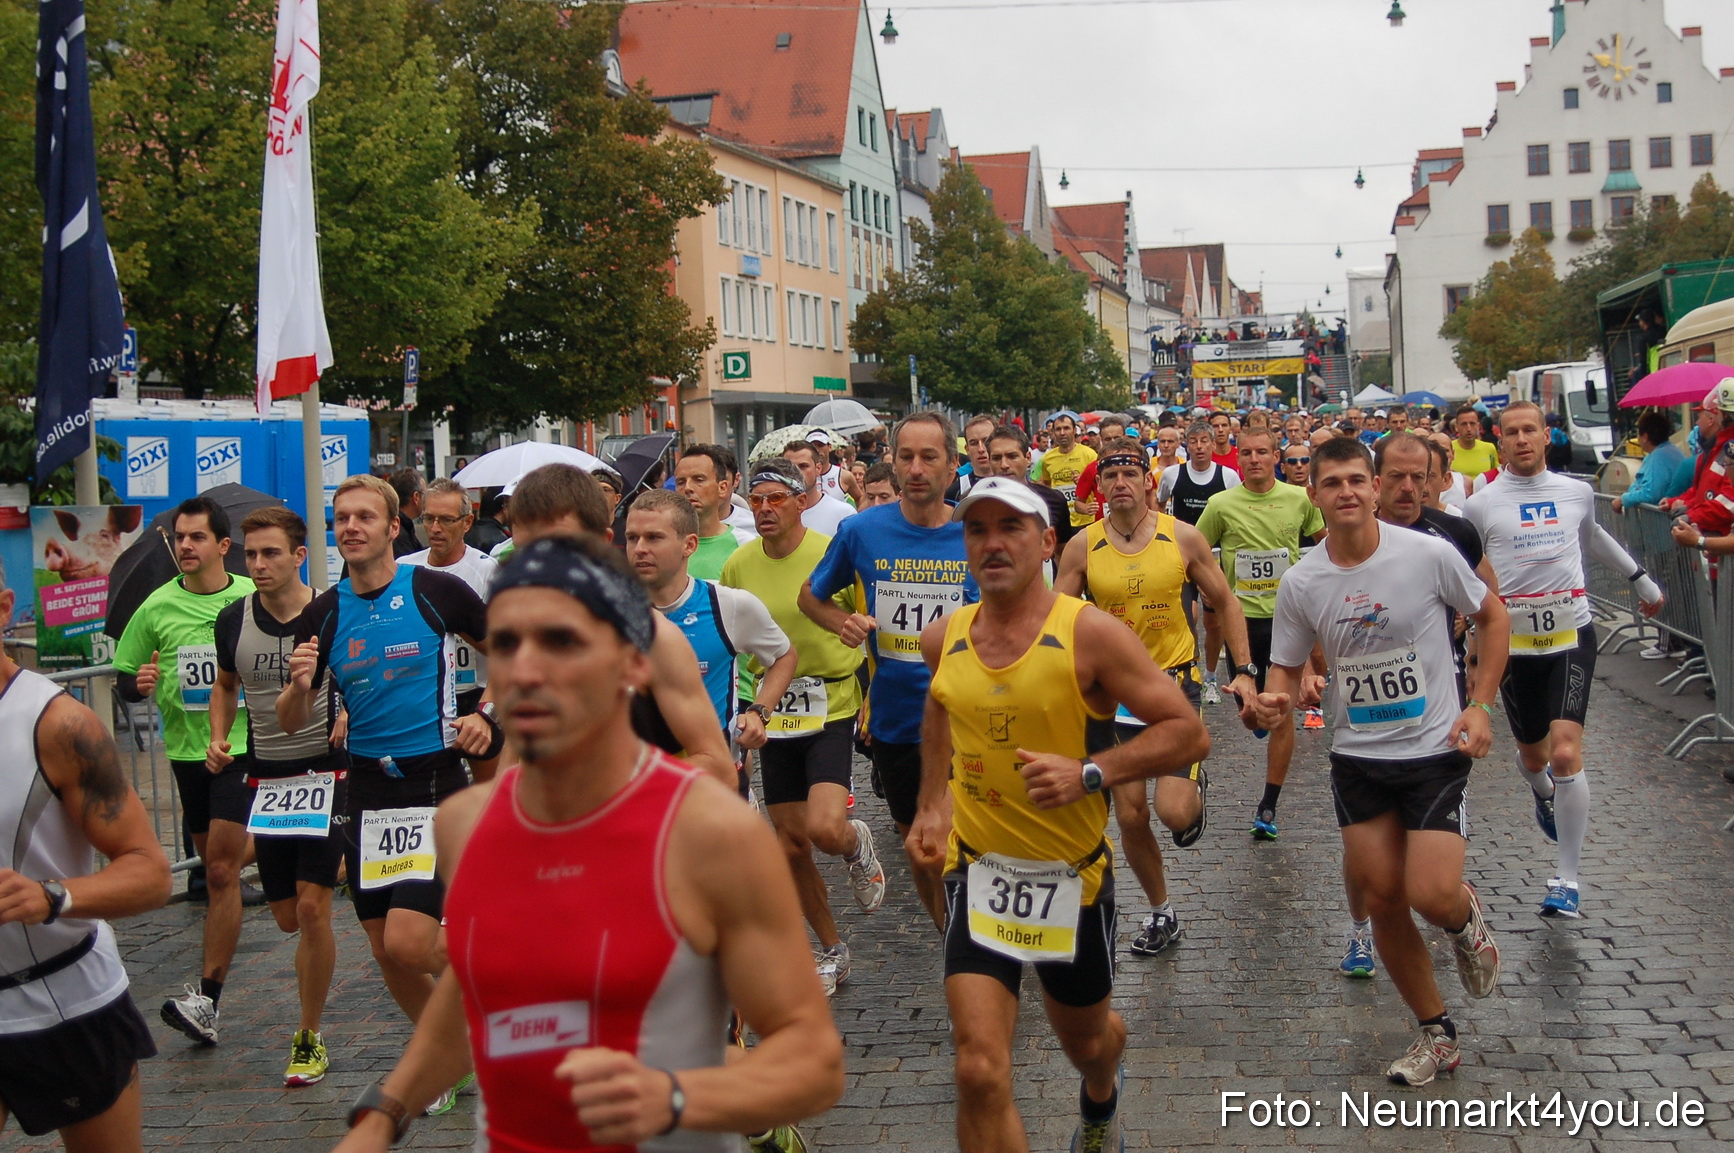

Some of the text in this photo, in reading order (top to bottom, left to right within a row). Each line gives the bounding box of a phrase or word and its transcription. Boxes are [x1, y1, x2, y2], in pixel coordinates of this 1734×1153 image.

[727, 355, 747, 376] D
[1228, 363, 1267, 374] START
[1513, 530, 1564, 541] Raiffeisenbank
[1527, 539, 1555, 548] Rothsee
[875, 559, 970, 572] 10. NEUMARKT
[1251, 561, 1274, 579] 59
[890, 570, 966, 584] STADTLAUF
[877, 588, 947, 601] PARTL Neumarkt
[46, 596, 75, 611] BEIDE
[72, 604, 100, 617] GRÜN
[1529, 600, 1561, 610] Neumarkt
[891, 603, 944, 632] 414
[1527, 610, 1556, 633] 18
[1532, 637, 1554, 647] Andy
[179, 651, 202, 660] PARTL
[1338, 657, 1404, 673] PARTL Neumarkt
[1345, 666, 1418, 703] 2166
[1369, 707, 1407, 721] Fabian
[781, 718, 801, 729] Ralf
[962, 758, 984, 774] Seidl
[261, 787, 326, 812] 2420
[268, 816, 310, 827] Andreas
[364, 814, 429, 826] PARTL Neumarkt
[378, 825, 424, 856] 405
[380, 859, 414, 876] Andreas
[1009, 867, 1062, 877] Neumarkt
[988, 876, 1059, 920] 367
[996, 924, 1044, 946] Robert
[511, 1016, 559, 1041] DEHN
